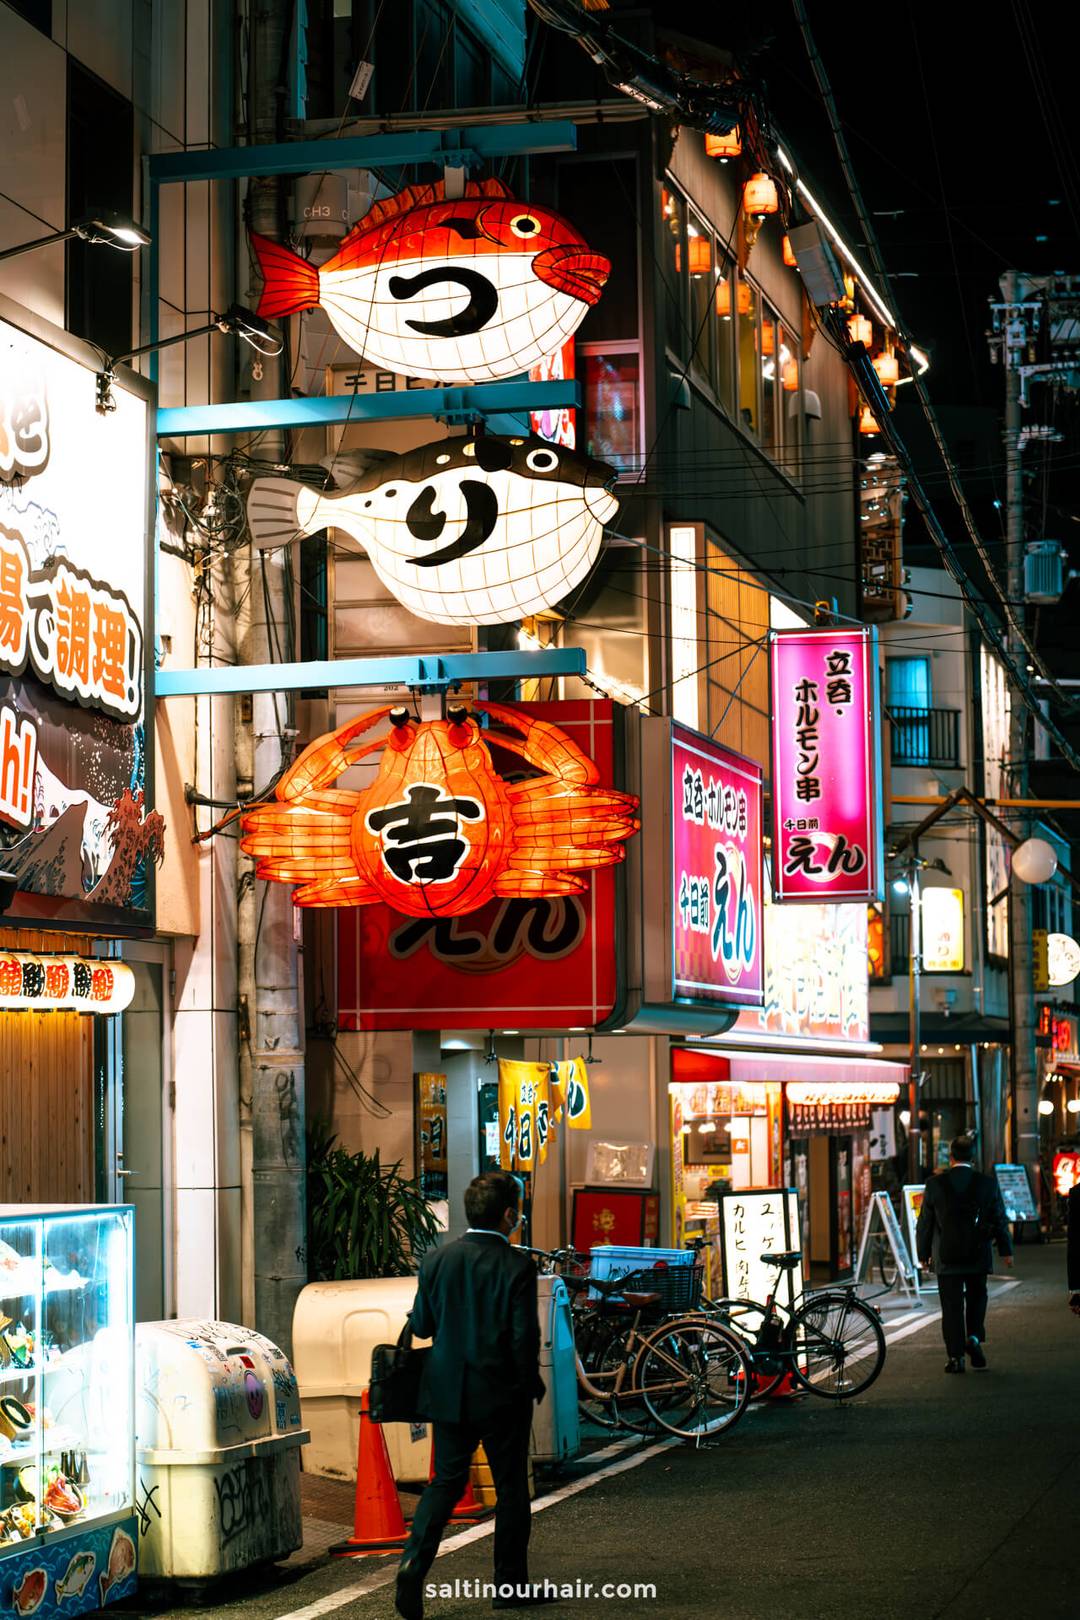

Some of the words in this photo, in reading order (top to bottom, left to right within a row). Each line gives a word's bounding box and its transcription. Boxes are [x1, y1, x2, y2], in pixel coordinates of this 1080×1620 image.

[388, 265, 499, 338] つ
[405, 478, 499, 568] り
[794, 678, 821, 804] ホルモン串
[366, 783, 485, 885] 吉
[784, 834, 866, 876] えん
[712, 846, 755, 967] えん
